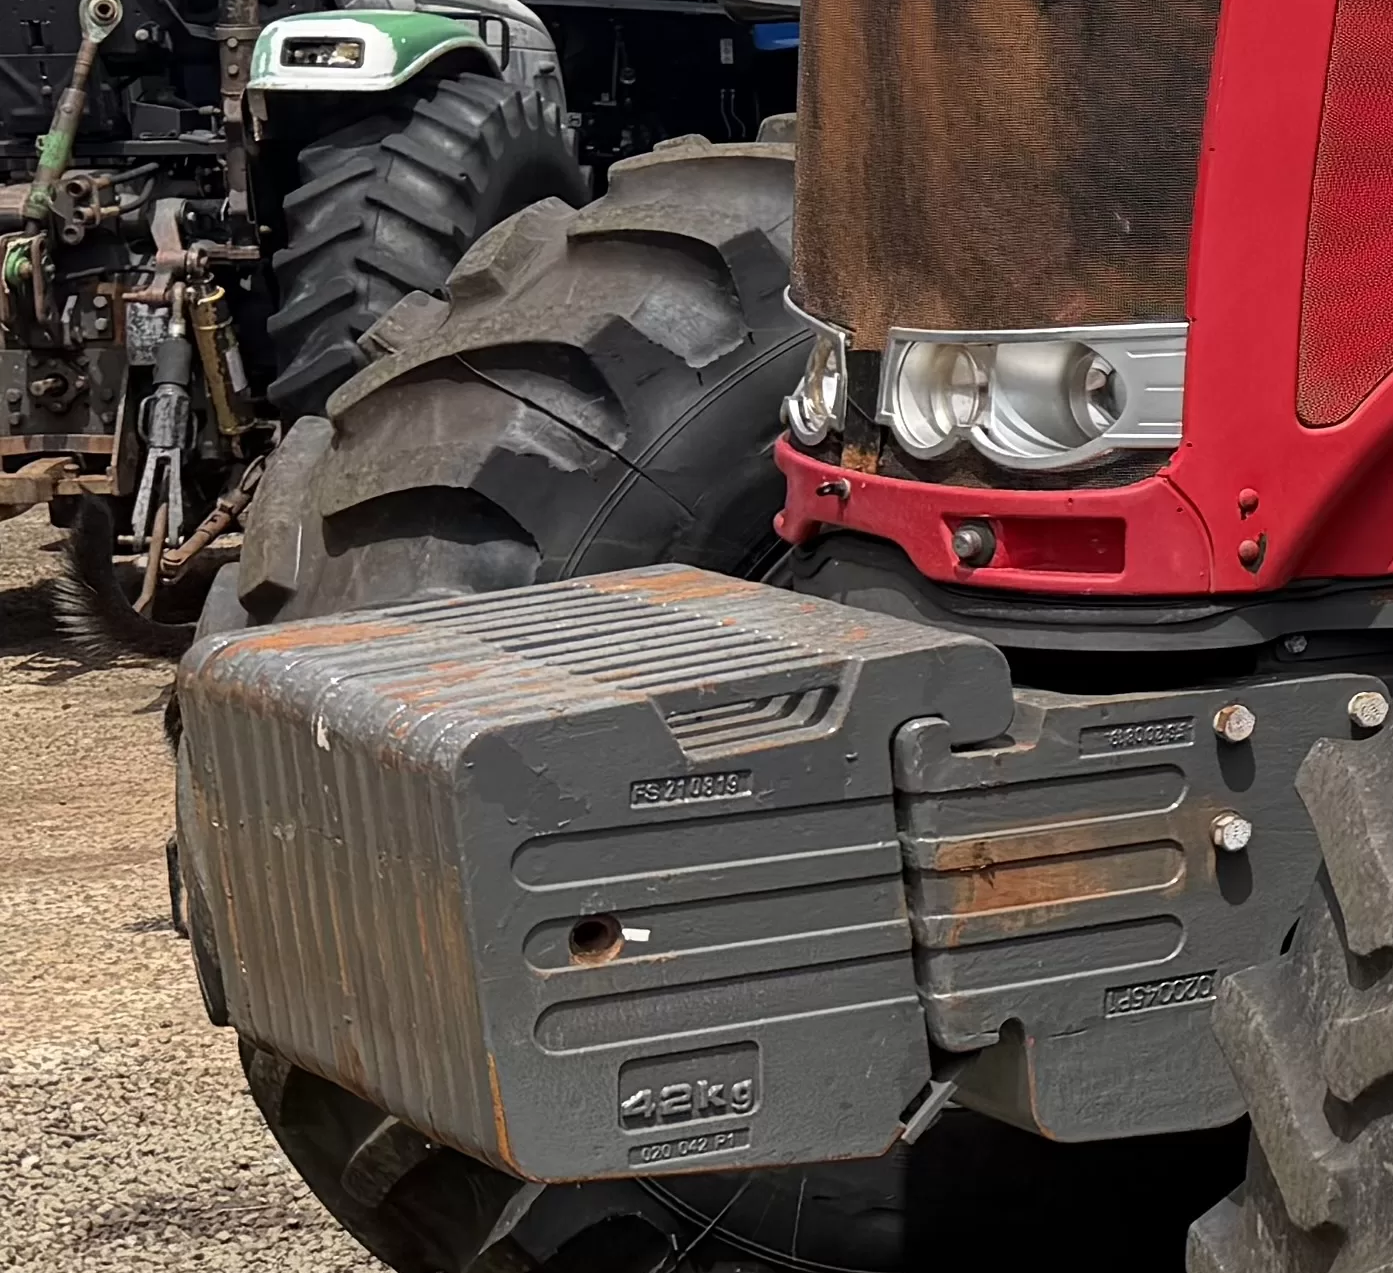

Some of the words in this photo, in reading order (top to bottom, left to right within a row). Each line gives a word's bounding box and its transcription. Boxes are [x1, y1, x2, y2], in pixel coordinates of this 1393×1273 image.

[620, 1078, 754, 1119] 42kg
[641, 1143, 671, 1161] 020
[677, 1137, 708, 1155] 042
[714, 1132, 735, 1150] P1
